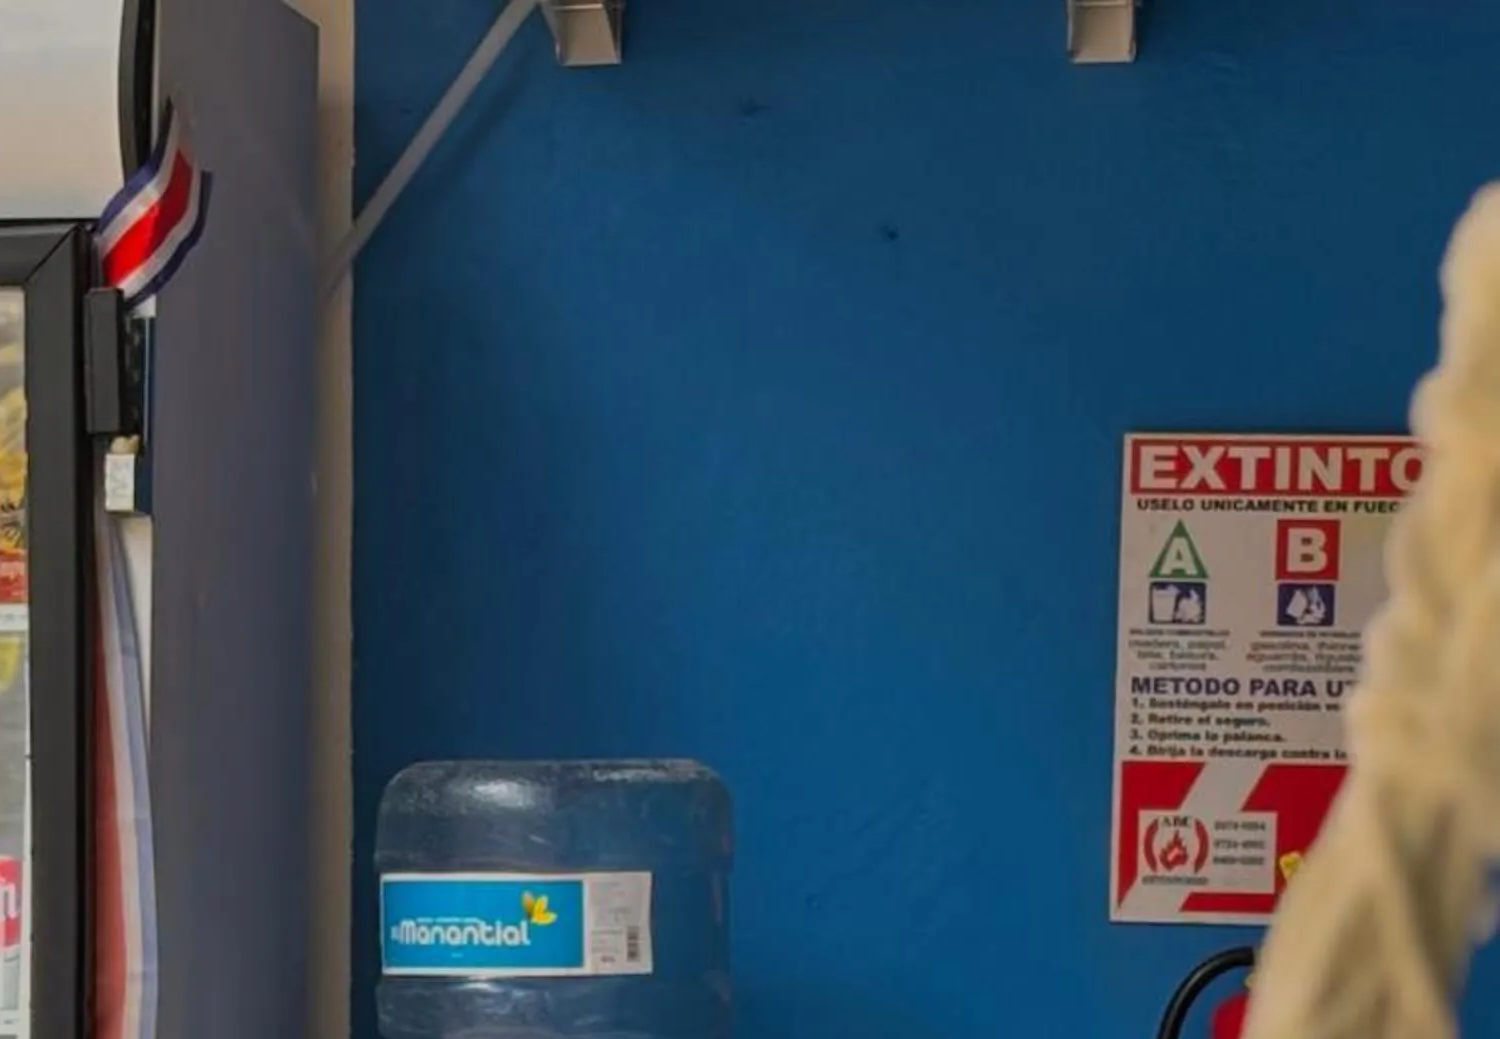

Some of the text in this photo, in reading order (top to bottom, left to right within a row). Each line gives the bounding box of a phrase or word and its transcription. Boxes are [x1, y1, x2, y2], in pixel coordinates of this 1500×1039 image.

[1138, 445, 1426, 491] EXTINTO
[1137, 498, 1195, 512] USELO
[1201, 499, 1317, 513] UNICAMENTE
[1324, 501, 1348, 513] EN
[1158, 536, 1199, 576] A
[1286, 527, 1329, 573] B
[1131, 676, 1241, 696] METODO
[1250, 678, 1317, 697] PARA
